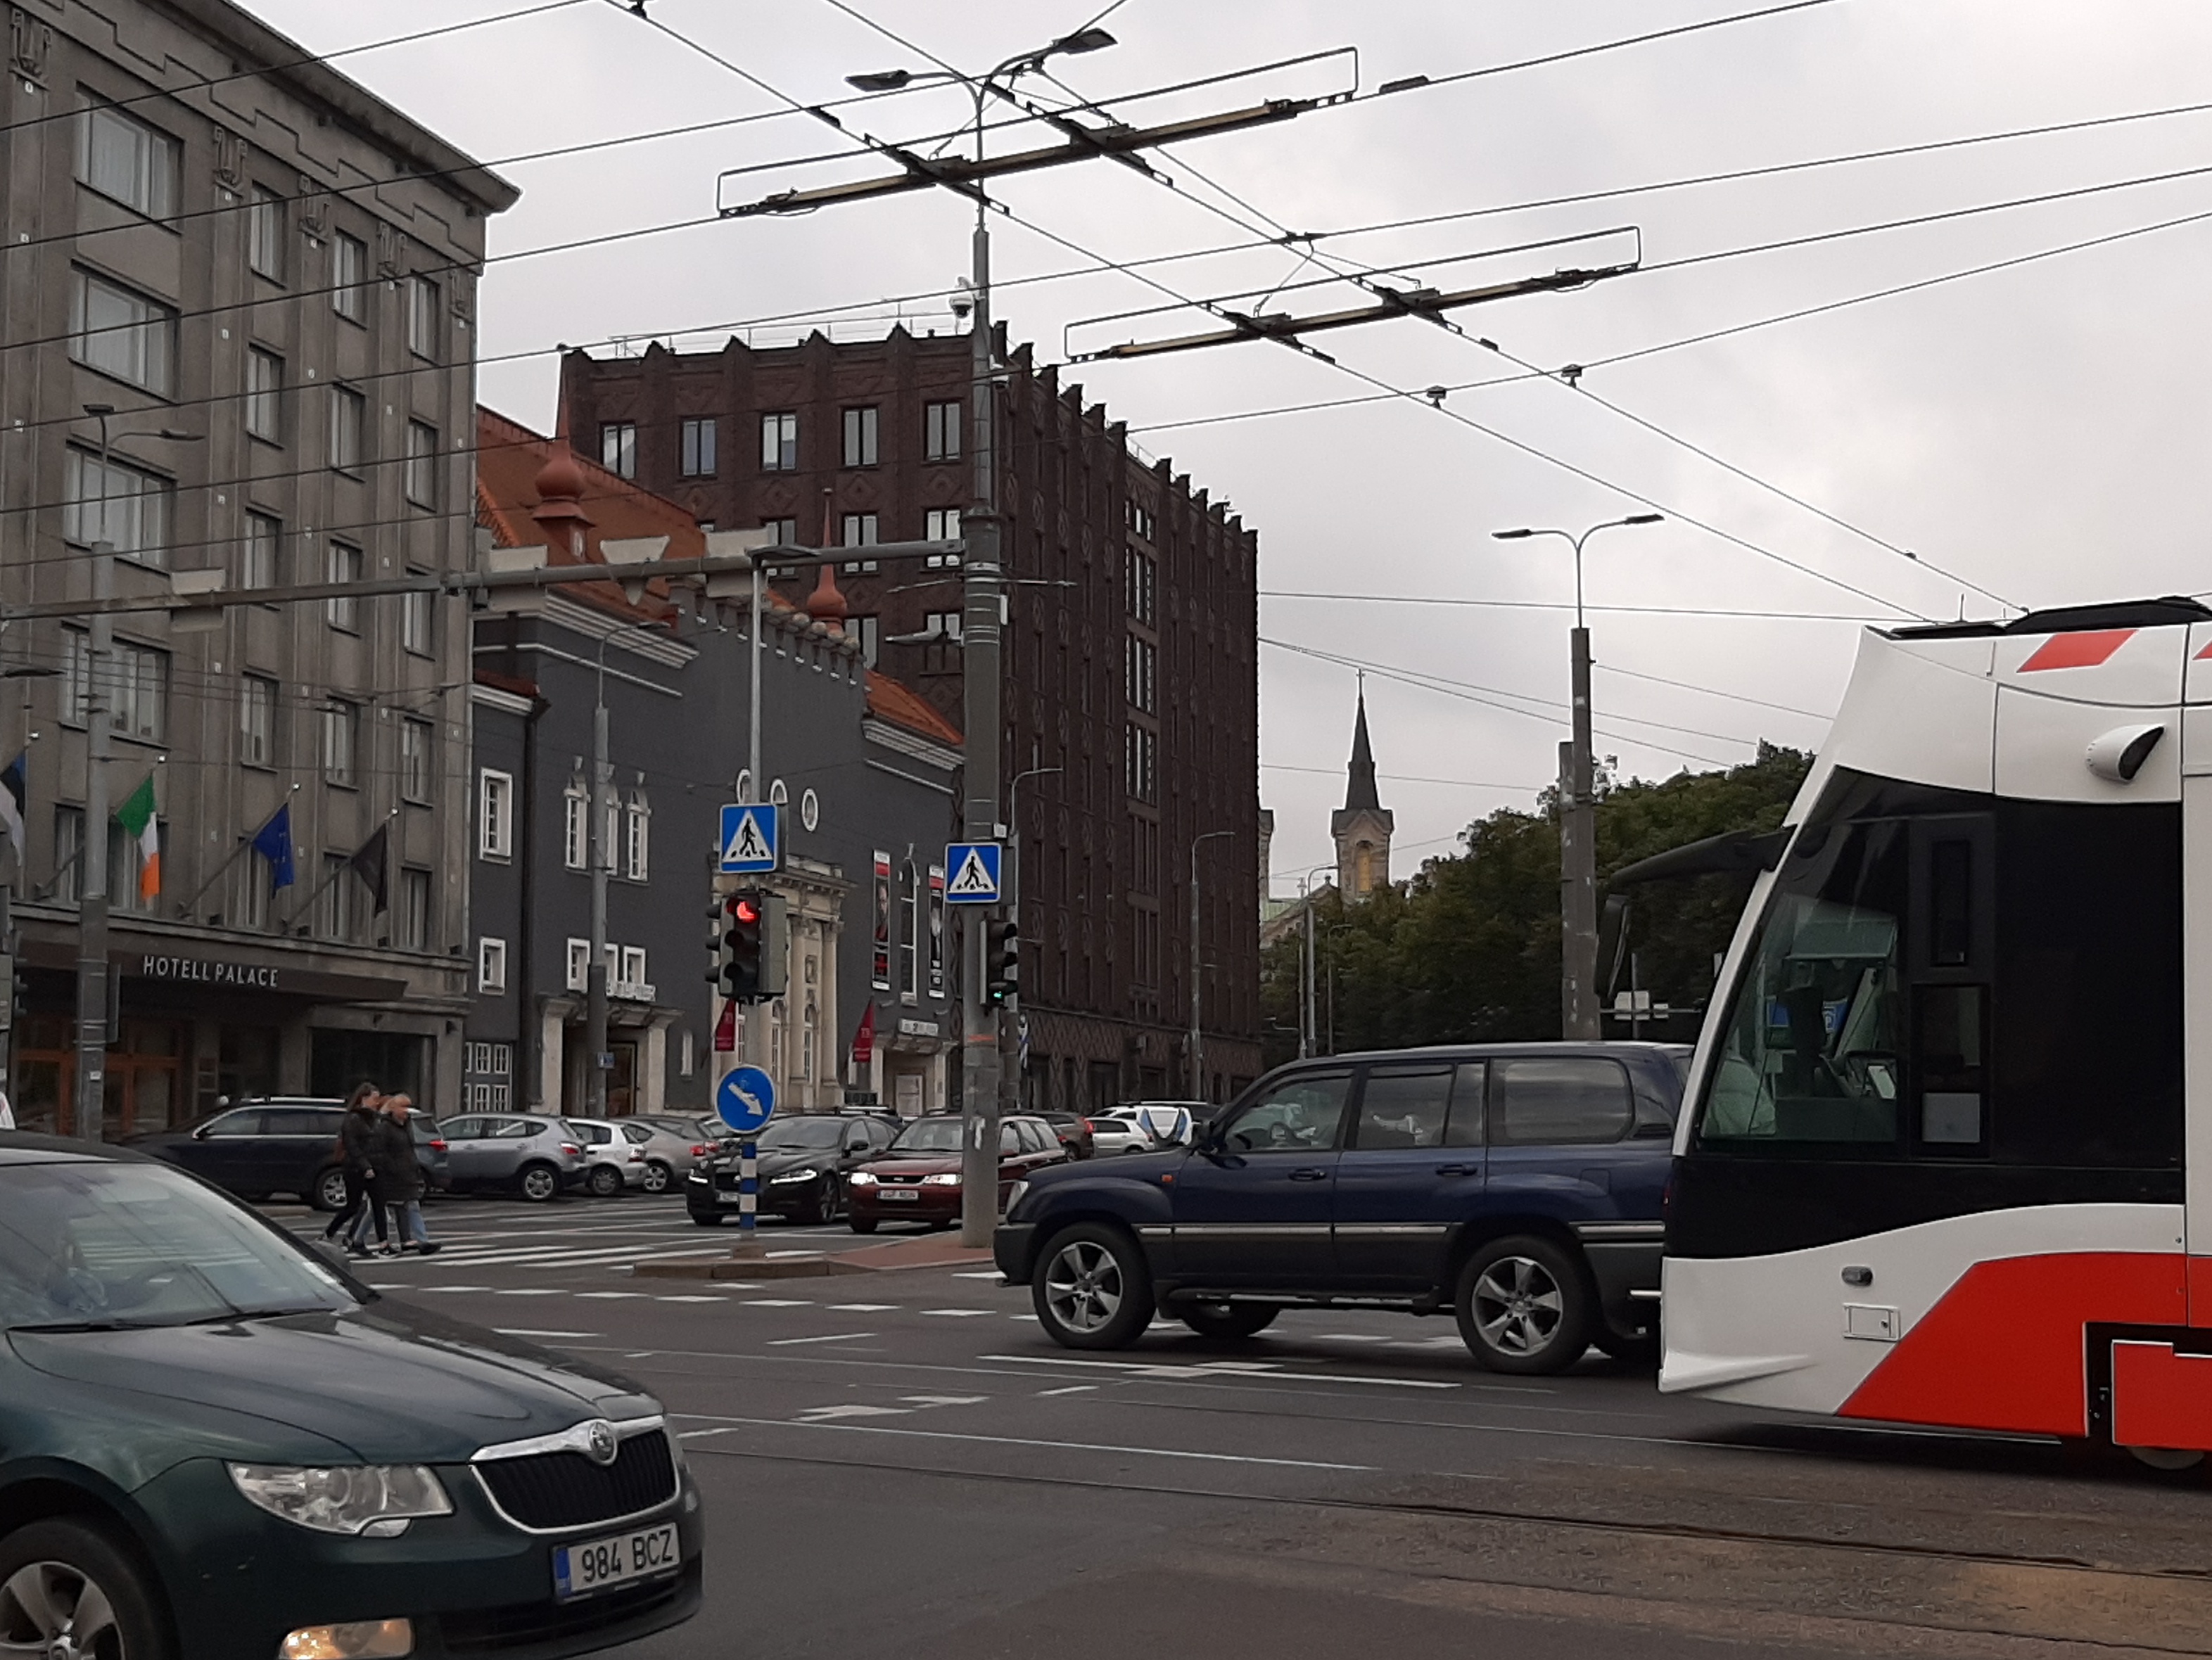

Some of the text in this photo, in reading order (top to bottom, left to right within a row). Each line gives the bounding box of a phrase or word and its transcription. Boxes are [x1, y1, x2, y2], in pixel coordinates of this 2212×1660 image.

[143, 954, 279, 988] HOTELL PALACE
[581, 1529, 673, 1582] 984 BCZ
